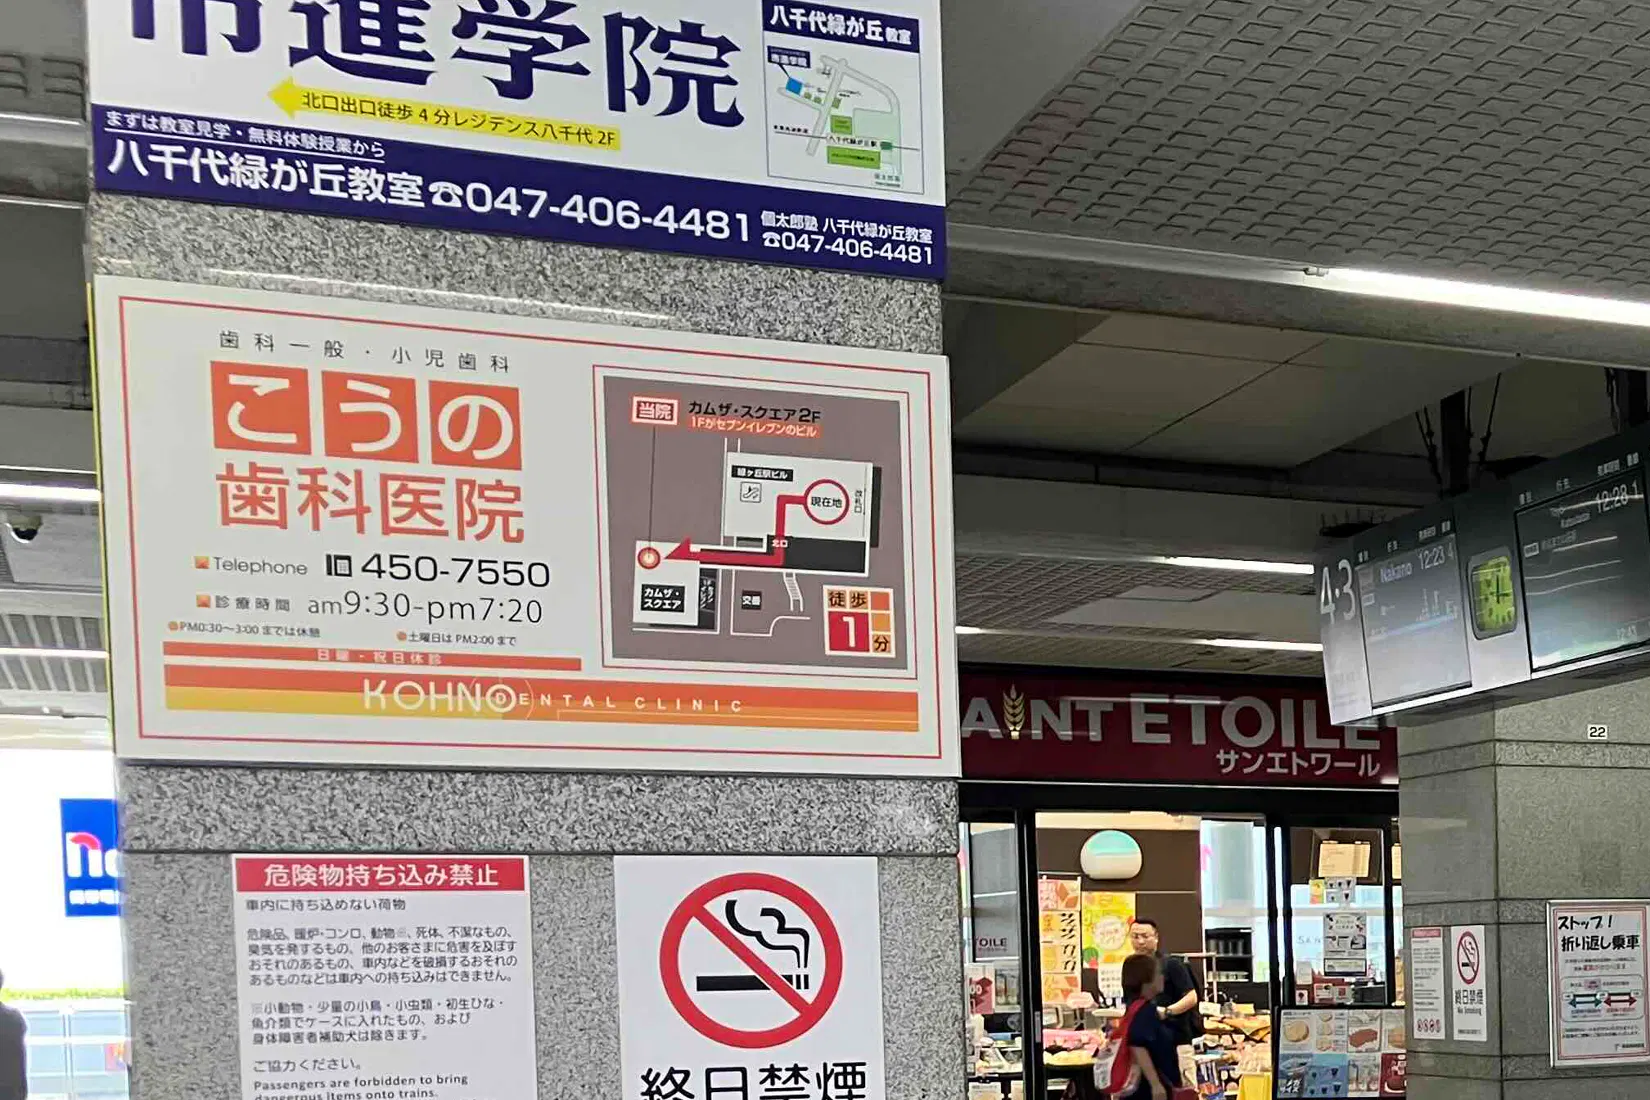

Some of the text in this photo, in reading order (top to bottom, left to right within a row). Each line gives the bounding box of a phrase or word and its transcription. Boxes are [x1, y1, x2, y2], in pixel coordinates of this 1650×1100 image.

[107, 138, 751, 243] 八千代緑が丘教室 047-406-4481
[781, 231, 933, 266] 047-406-4481
[219, 330, 510, 373] 歯科一般・小児歯科
[227, 373, 515, 462] こうの
[636, 402, 674, 420] 当院
[690, 417, 818, 438] 1Fがセブンイレブンのビル
[214, 461, 526, 544] 歯科医院
[811, 496, 843, 509] 現在地
[214, 553, 551, 588] Telephone 450-7550
[215, 594, 291, 613] 診療時間
[643, 597, 682, 608] スクエア
[829, 590, 867, 608] 徒歩
[842, 615, 856, 648] 1
[873, 635, 891, 653] 分
[363, 678, 743, 713] KOHNO DENTAL CLINIC
[960, 684, 1114, 742] AINT
[1588, 726, 1607, 738] 22
[1215, 749, 1381, 778] サンエトワール
[264, 863, 499, 887] 危険物持ち込み禁止
[246, 898, 406, 912] 車内に持ち込めない荷物
[1561, 934, 1640, 952] 折り返し乗車
[253, 1058, 361, 1073] ご協力ください。
[253, 1074, 469, 1092] Passengers are forbidden to bring
[326, 1090, 362, 1100] items
[366, 1090, 396, 1100] onto
